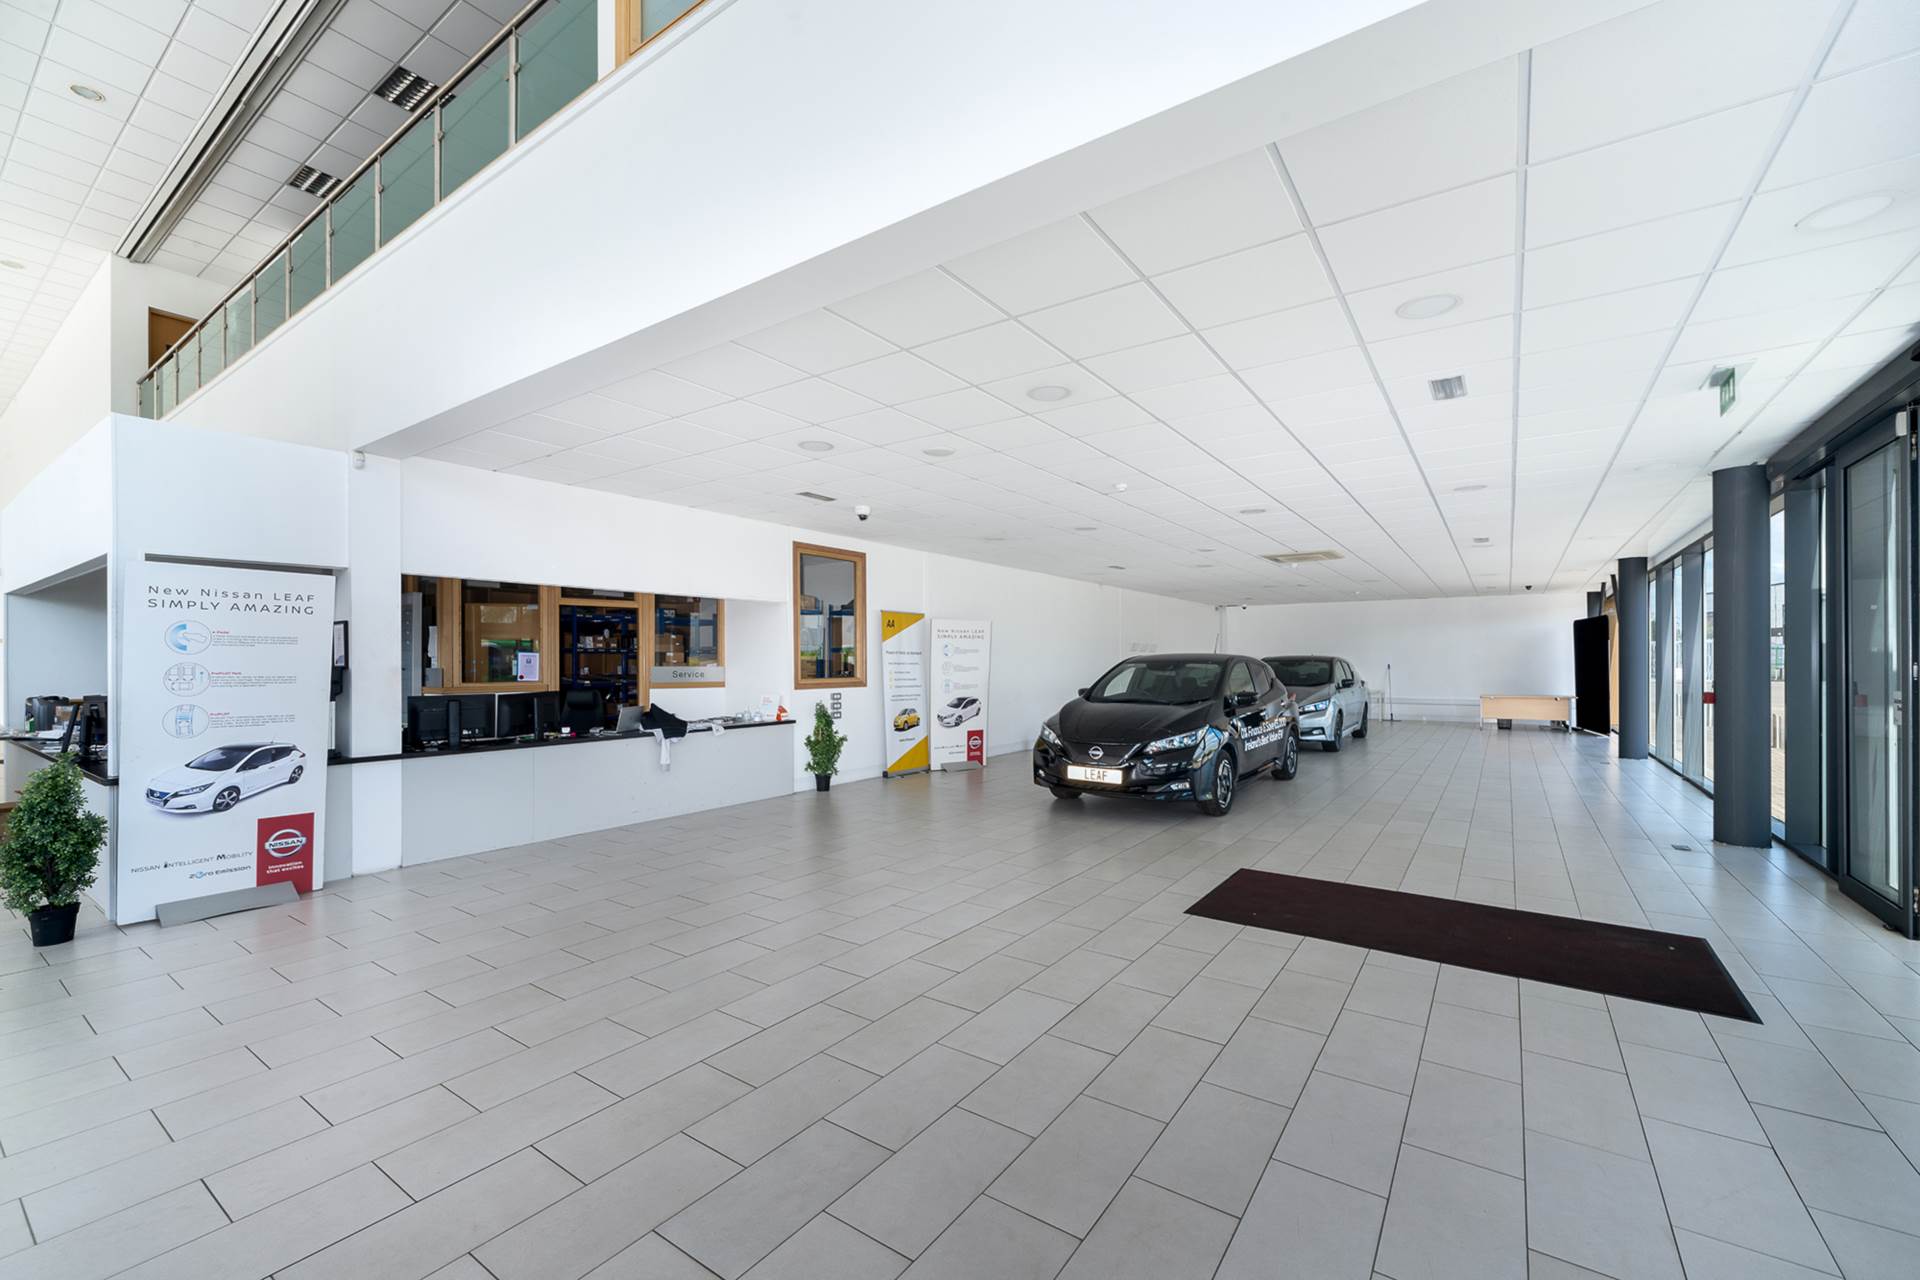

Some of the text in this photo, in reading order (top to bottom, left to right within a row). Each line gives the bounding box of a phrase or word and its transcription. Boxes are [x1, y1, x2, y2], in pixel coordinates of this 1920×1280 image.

[148, 585, 315, 602] New Nissan LEAF
[147, 599, 314, 615] SIMPLY AMAZING
[886, 619, 895, 628] AA
[672, 670, 705, 679] Service
[1084, 768, 1108, 782] LEAF
[268, 838, 304, 848] NISSAN
[131, 864, 161, 873] NISSAN
[216, 851, 254, 861] MOBILITY
